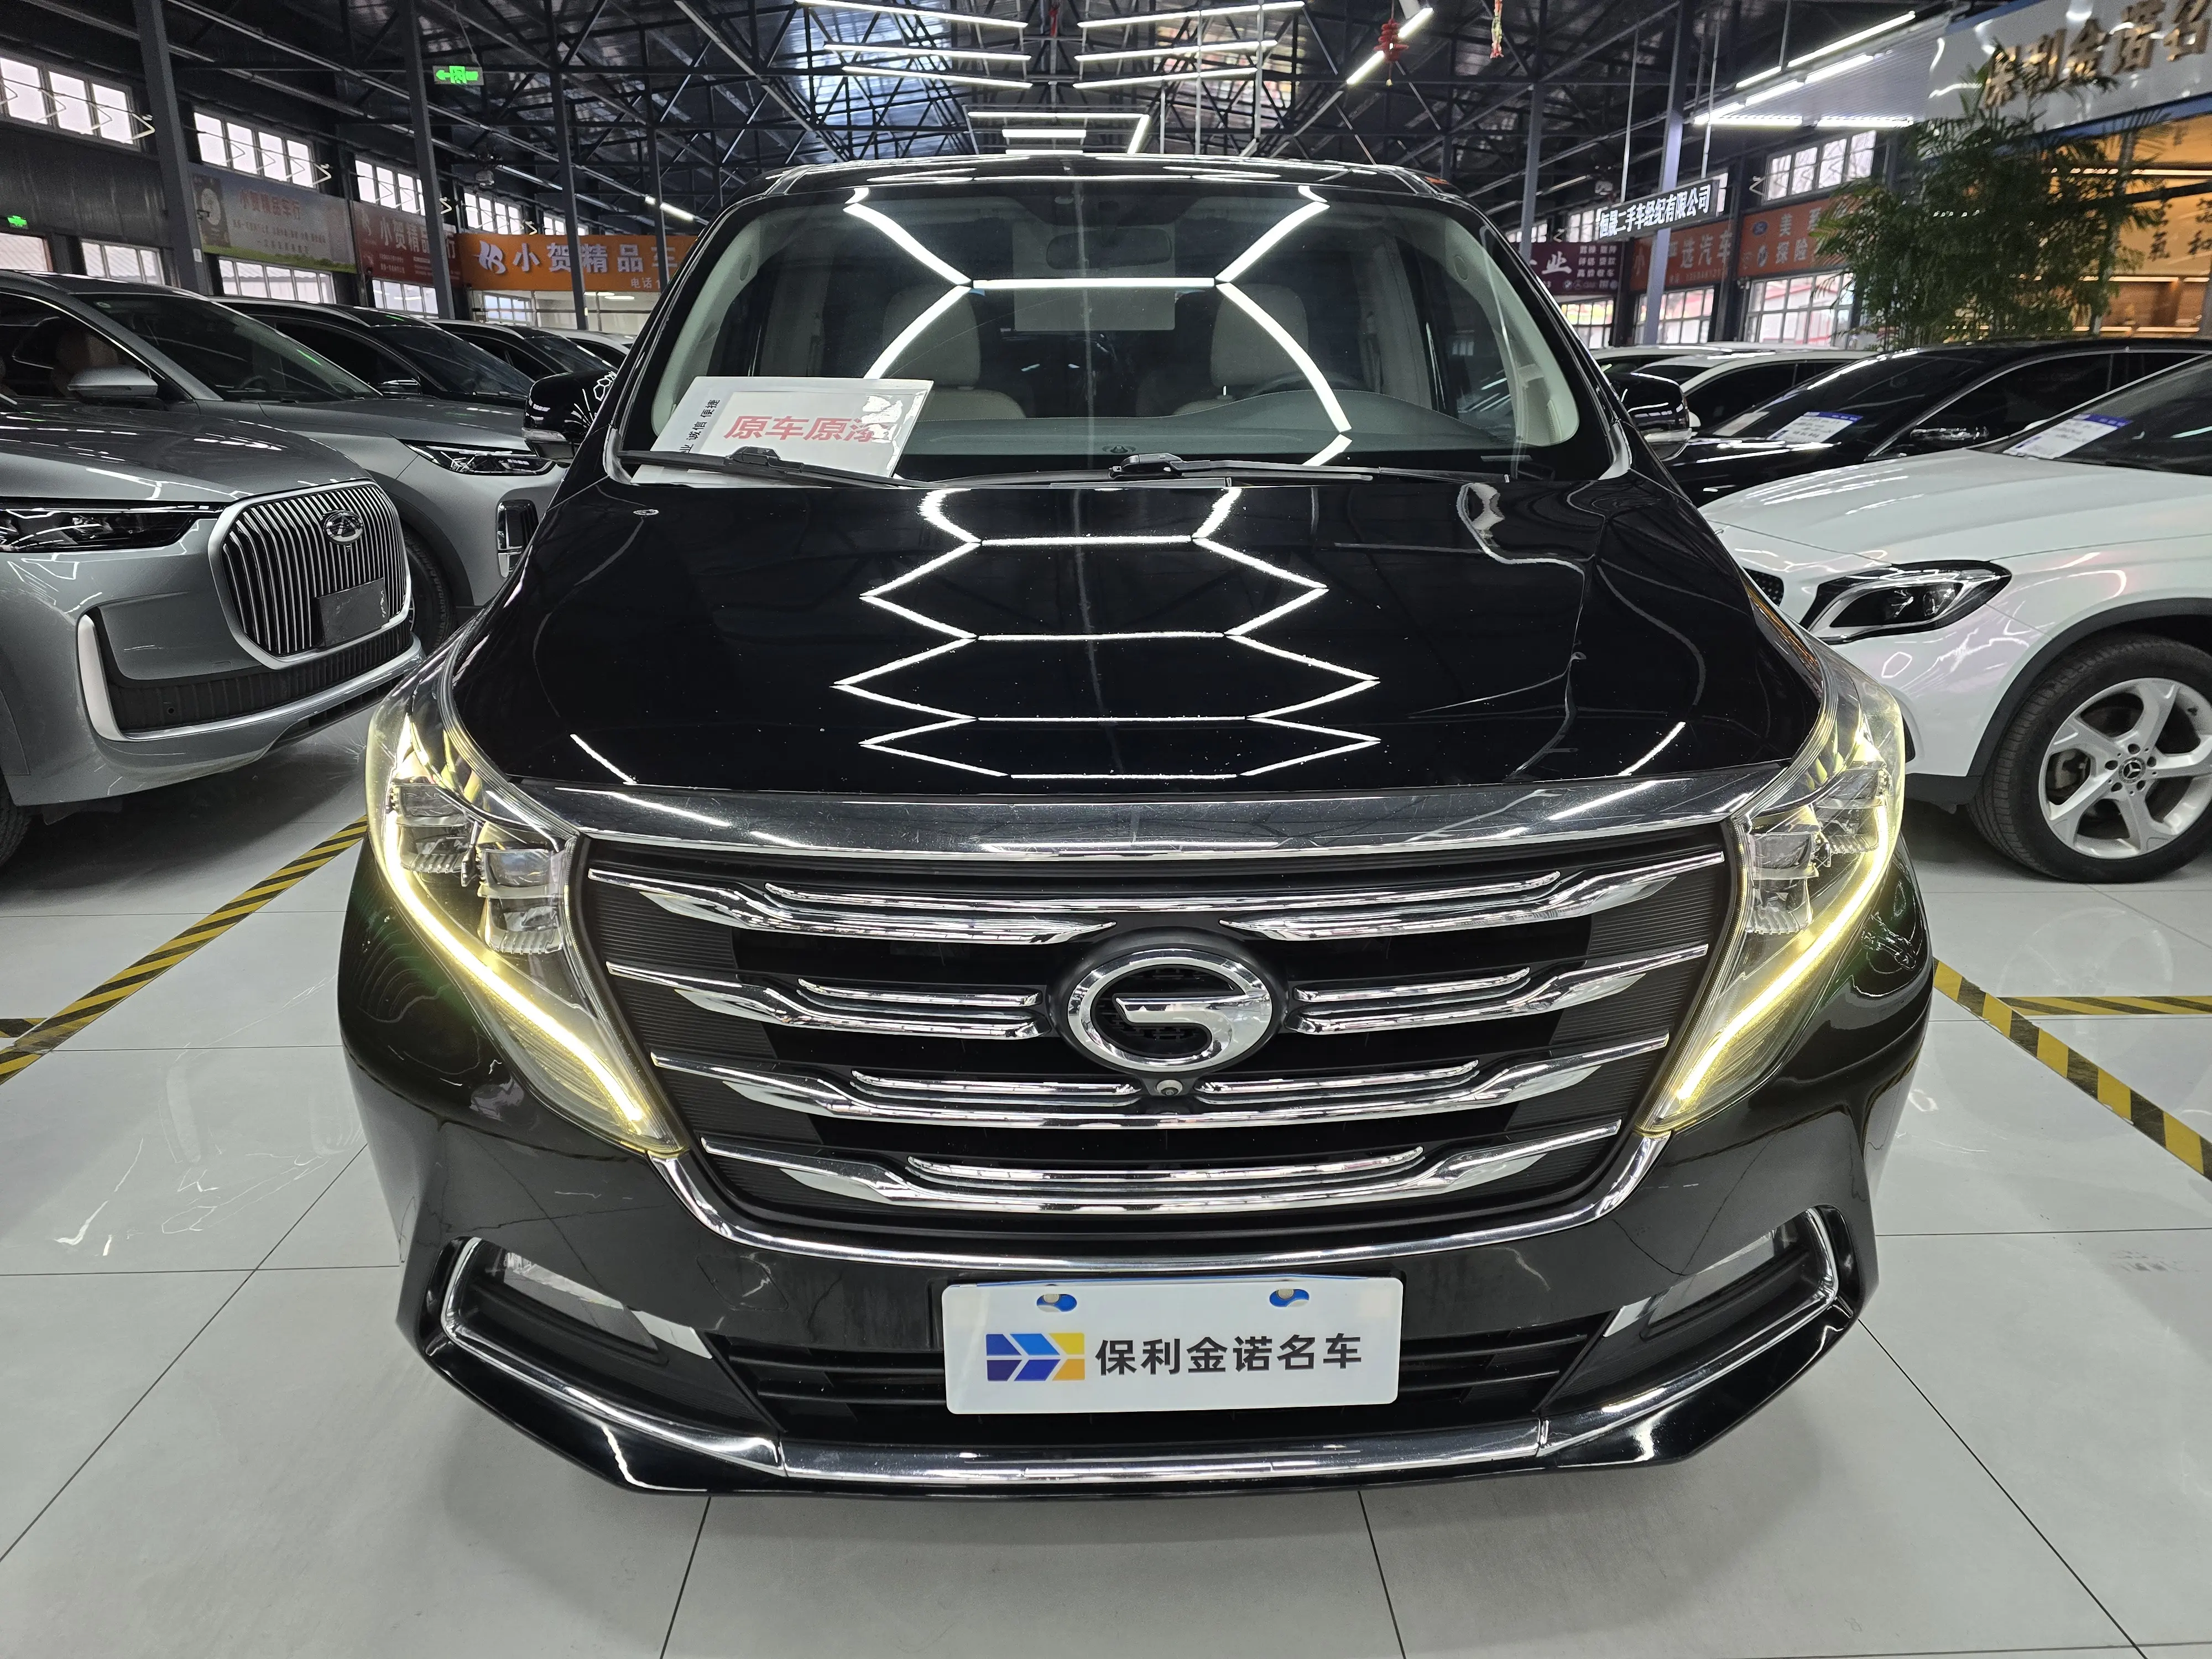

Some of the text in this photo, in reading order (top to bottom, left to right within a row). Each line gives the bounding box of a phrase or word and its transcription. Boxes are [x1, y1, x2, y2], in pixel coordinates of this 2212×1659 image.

[380, 216, 456, 259] 小贺精品行
[630, 278, 652, 289] 电话
[1094, 1333, 1363, 1376] 保利金诺名车
